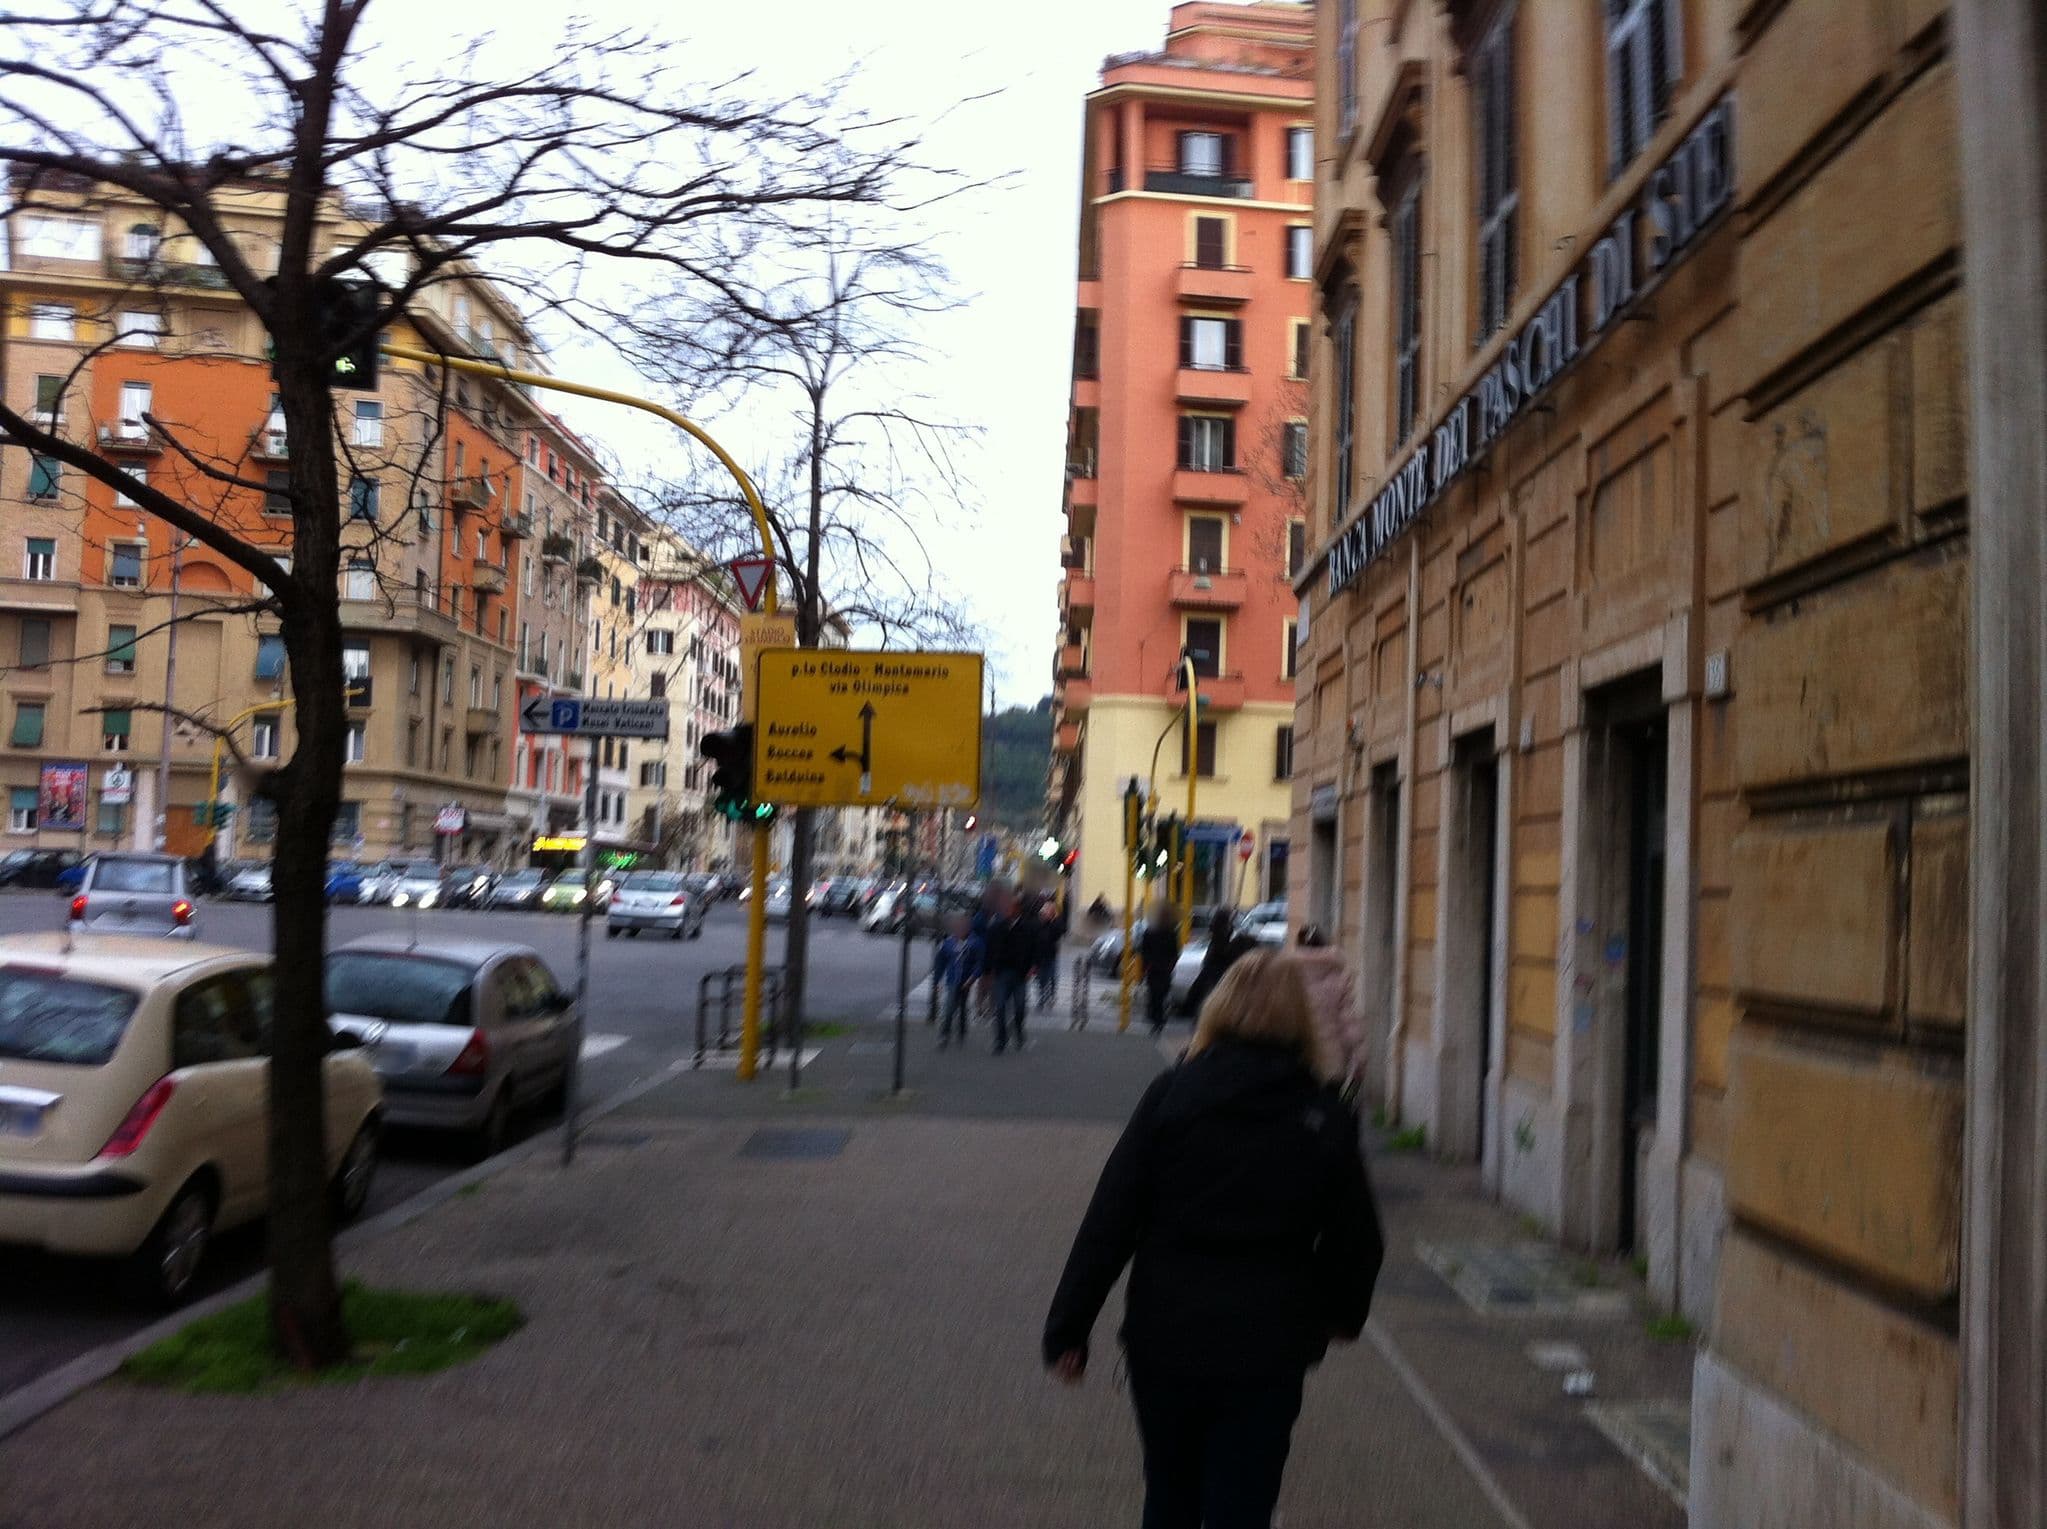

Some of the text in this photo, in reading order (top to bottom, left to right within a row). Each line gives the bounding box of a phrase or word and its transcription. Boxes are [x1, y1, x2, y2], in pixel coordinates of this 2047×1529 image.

[1328, 515, 1367, 599] BANCA
[1373, 445, 1428, 557] MONTE
[1433, 397, 1470, 492] DEI
[1480, 274, 1579, 443] PASCHI
[1588, 208, 1633, 328] DI
[820, 660, 861, 675] Clodio
[874, 662, 950, 679] Montemario
[830, 679, 909, 696] via Olimpica
[582, 717, 655, 729] Musei Vaticani
[766, 769, 825, 785] Balduina
